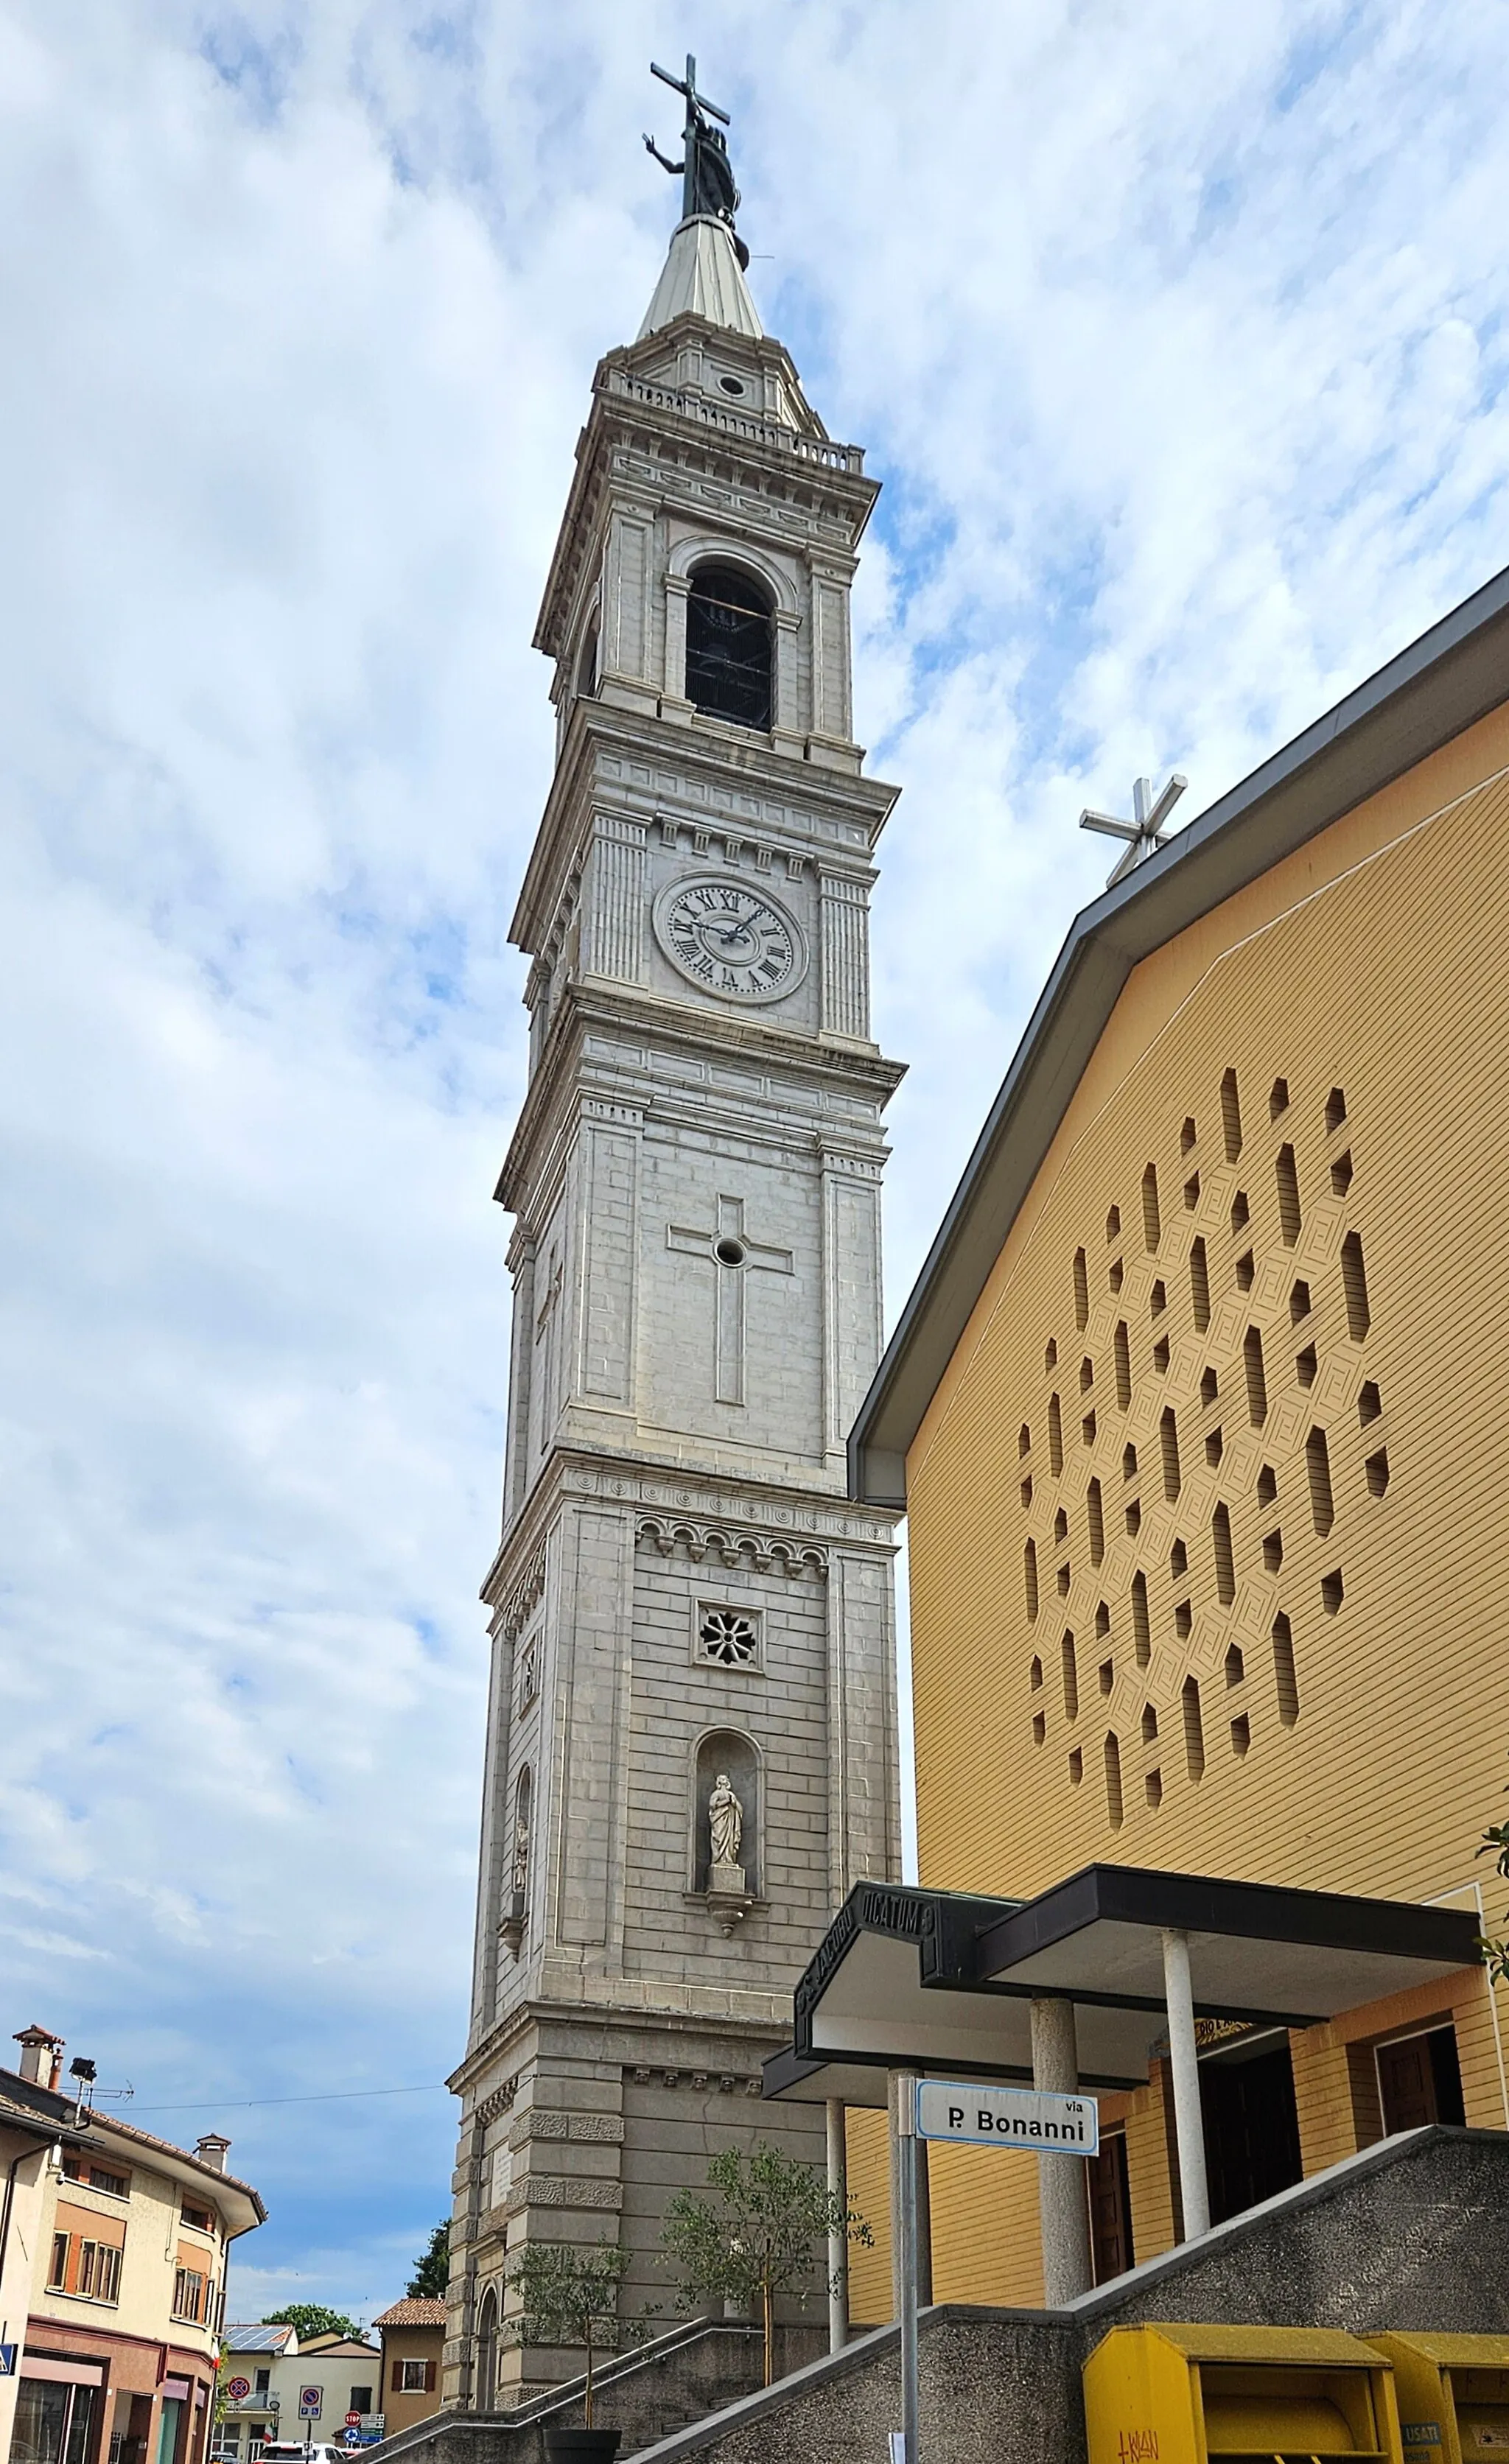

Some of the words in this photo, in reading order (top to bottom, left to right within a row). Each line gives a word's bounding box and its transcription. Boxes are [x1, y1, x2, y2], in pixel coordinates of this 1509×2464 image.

[863, 1891, 920, 1934] DICATUM
[948, 2107, 964, 2129] P.
[978, 2110, 1084, 2141] Bonanni
[1065, 2101, 1083, 2113] via
